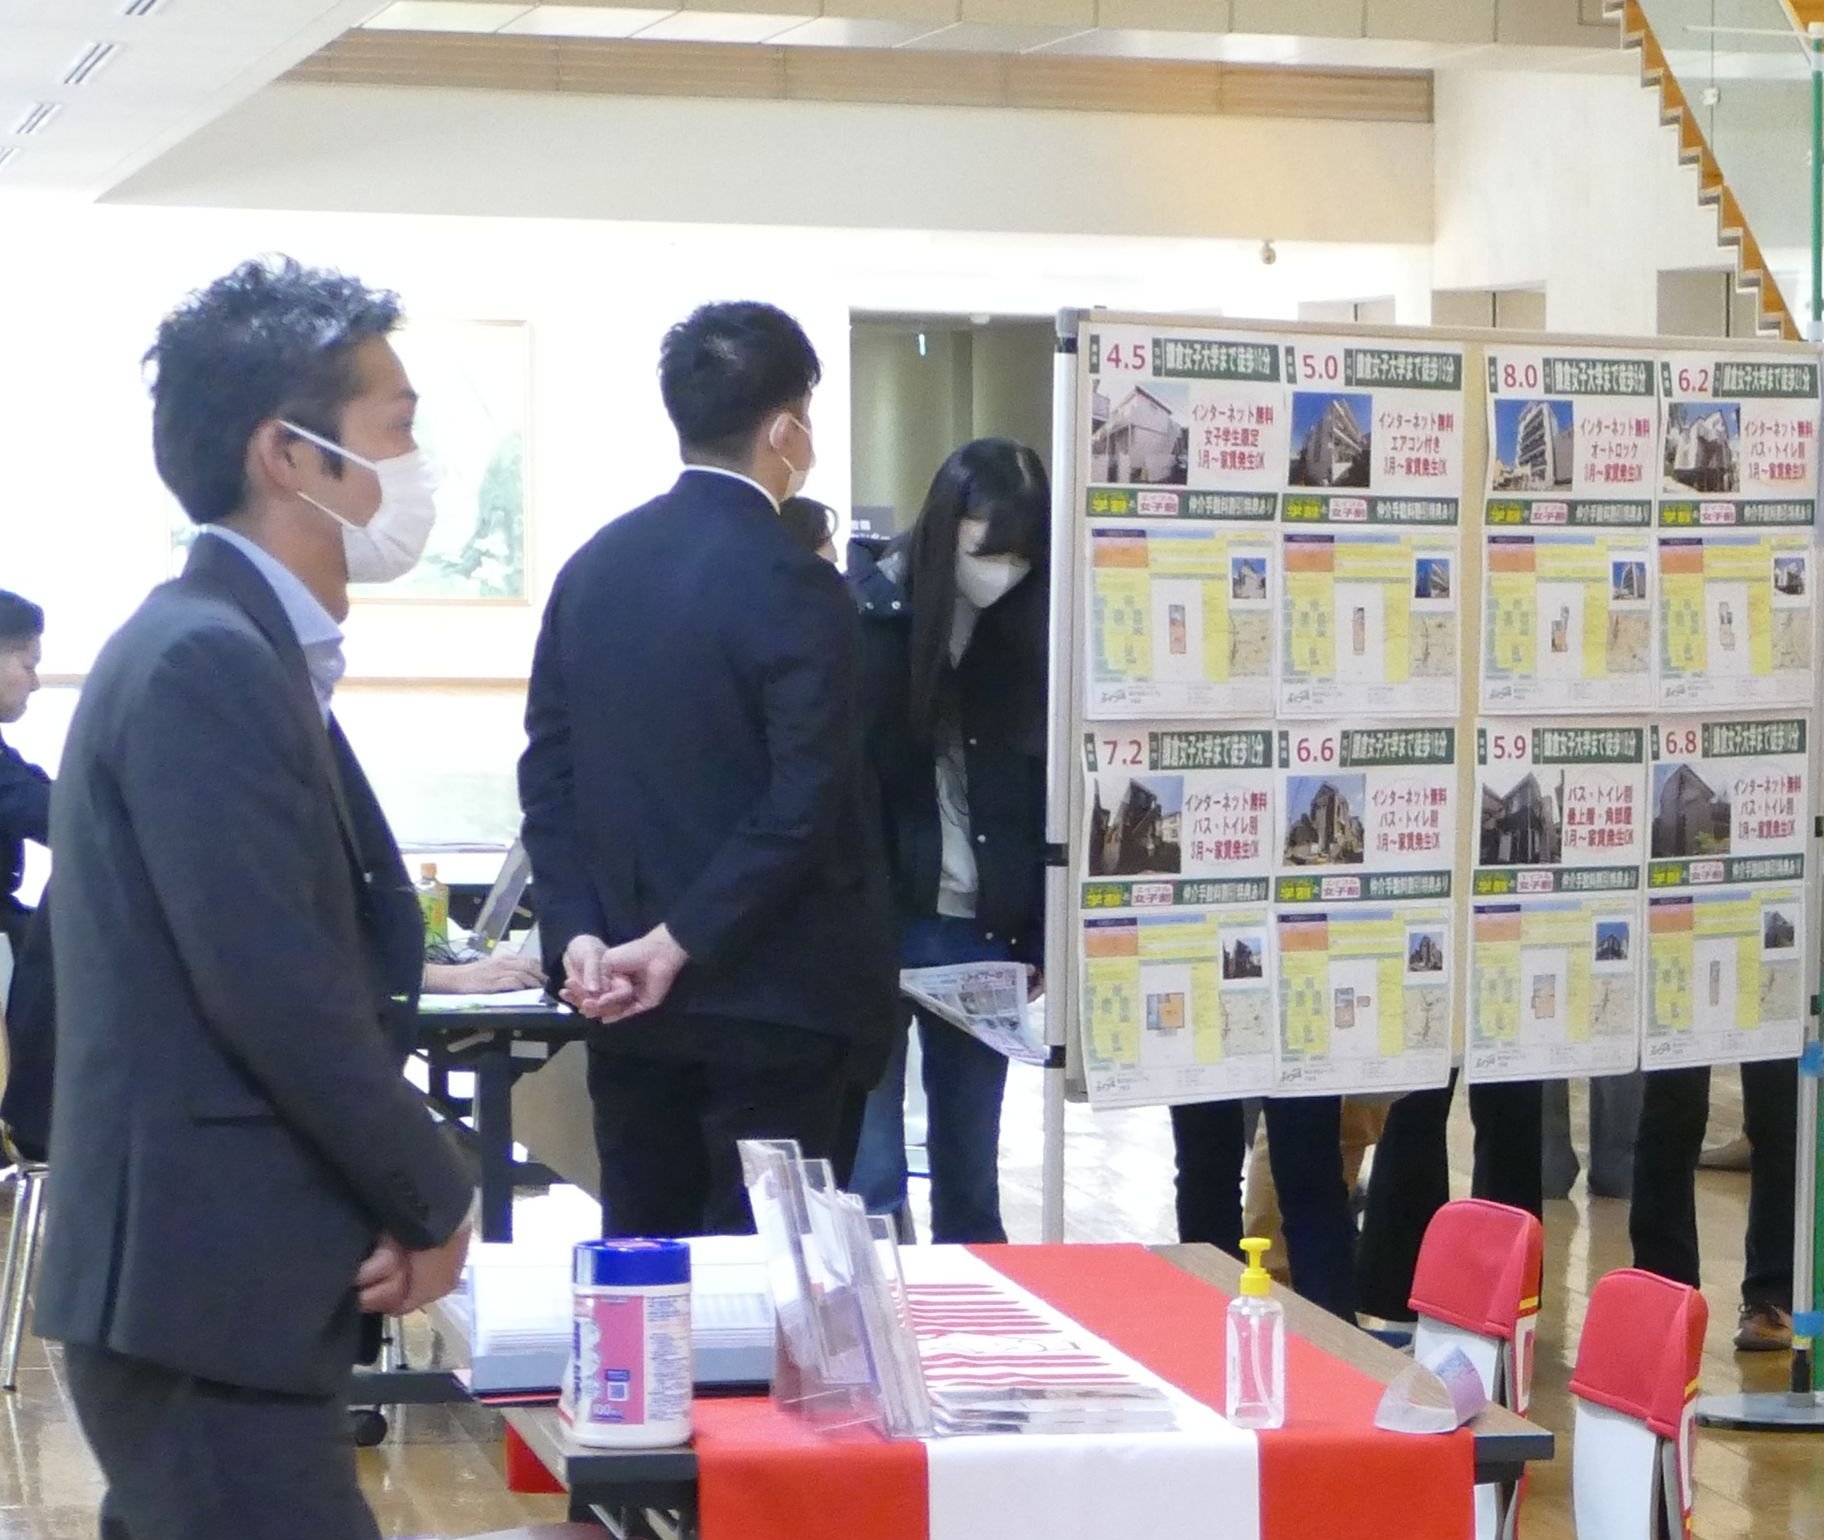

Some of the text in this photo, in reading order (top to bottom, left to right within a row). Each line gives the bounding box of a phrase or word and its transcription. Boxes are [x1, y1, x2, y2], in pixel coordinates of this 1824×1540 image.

[1106, 344, 1146, 370] 4.5
[1303, 354, 1338, 380] 5.0
[1504, 364, 1538, 389] 8.0
[1678, 368, 1709, 392] 6.2
[1103, 739, 1142, 764] 7.2
[1297, 737, 1334, 762] 6.6
[1494, 735, 1526, 759] 5.9
[1666, 730, 1696, 754] 6.8
